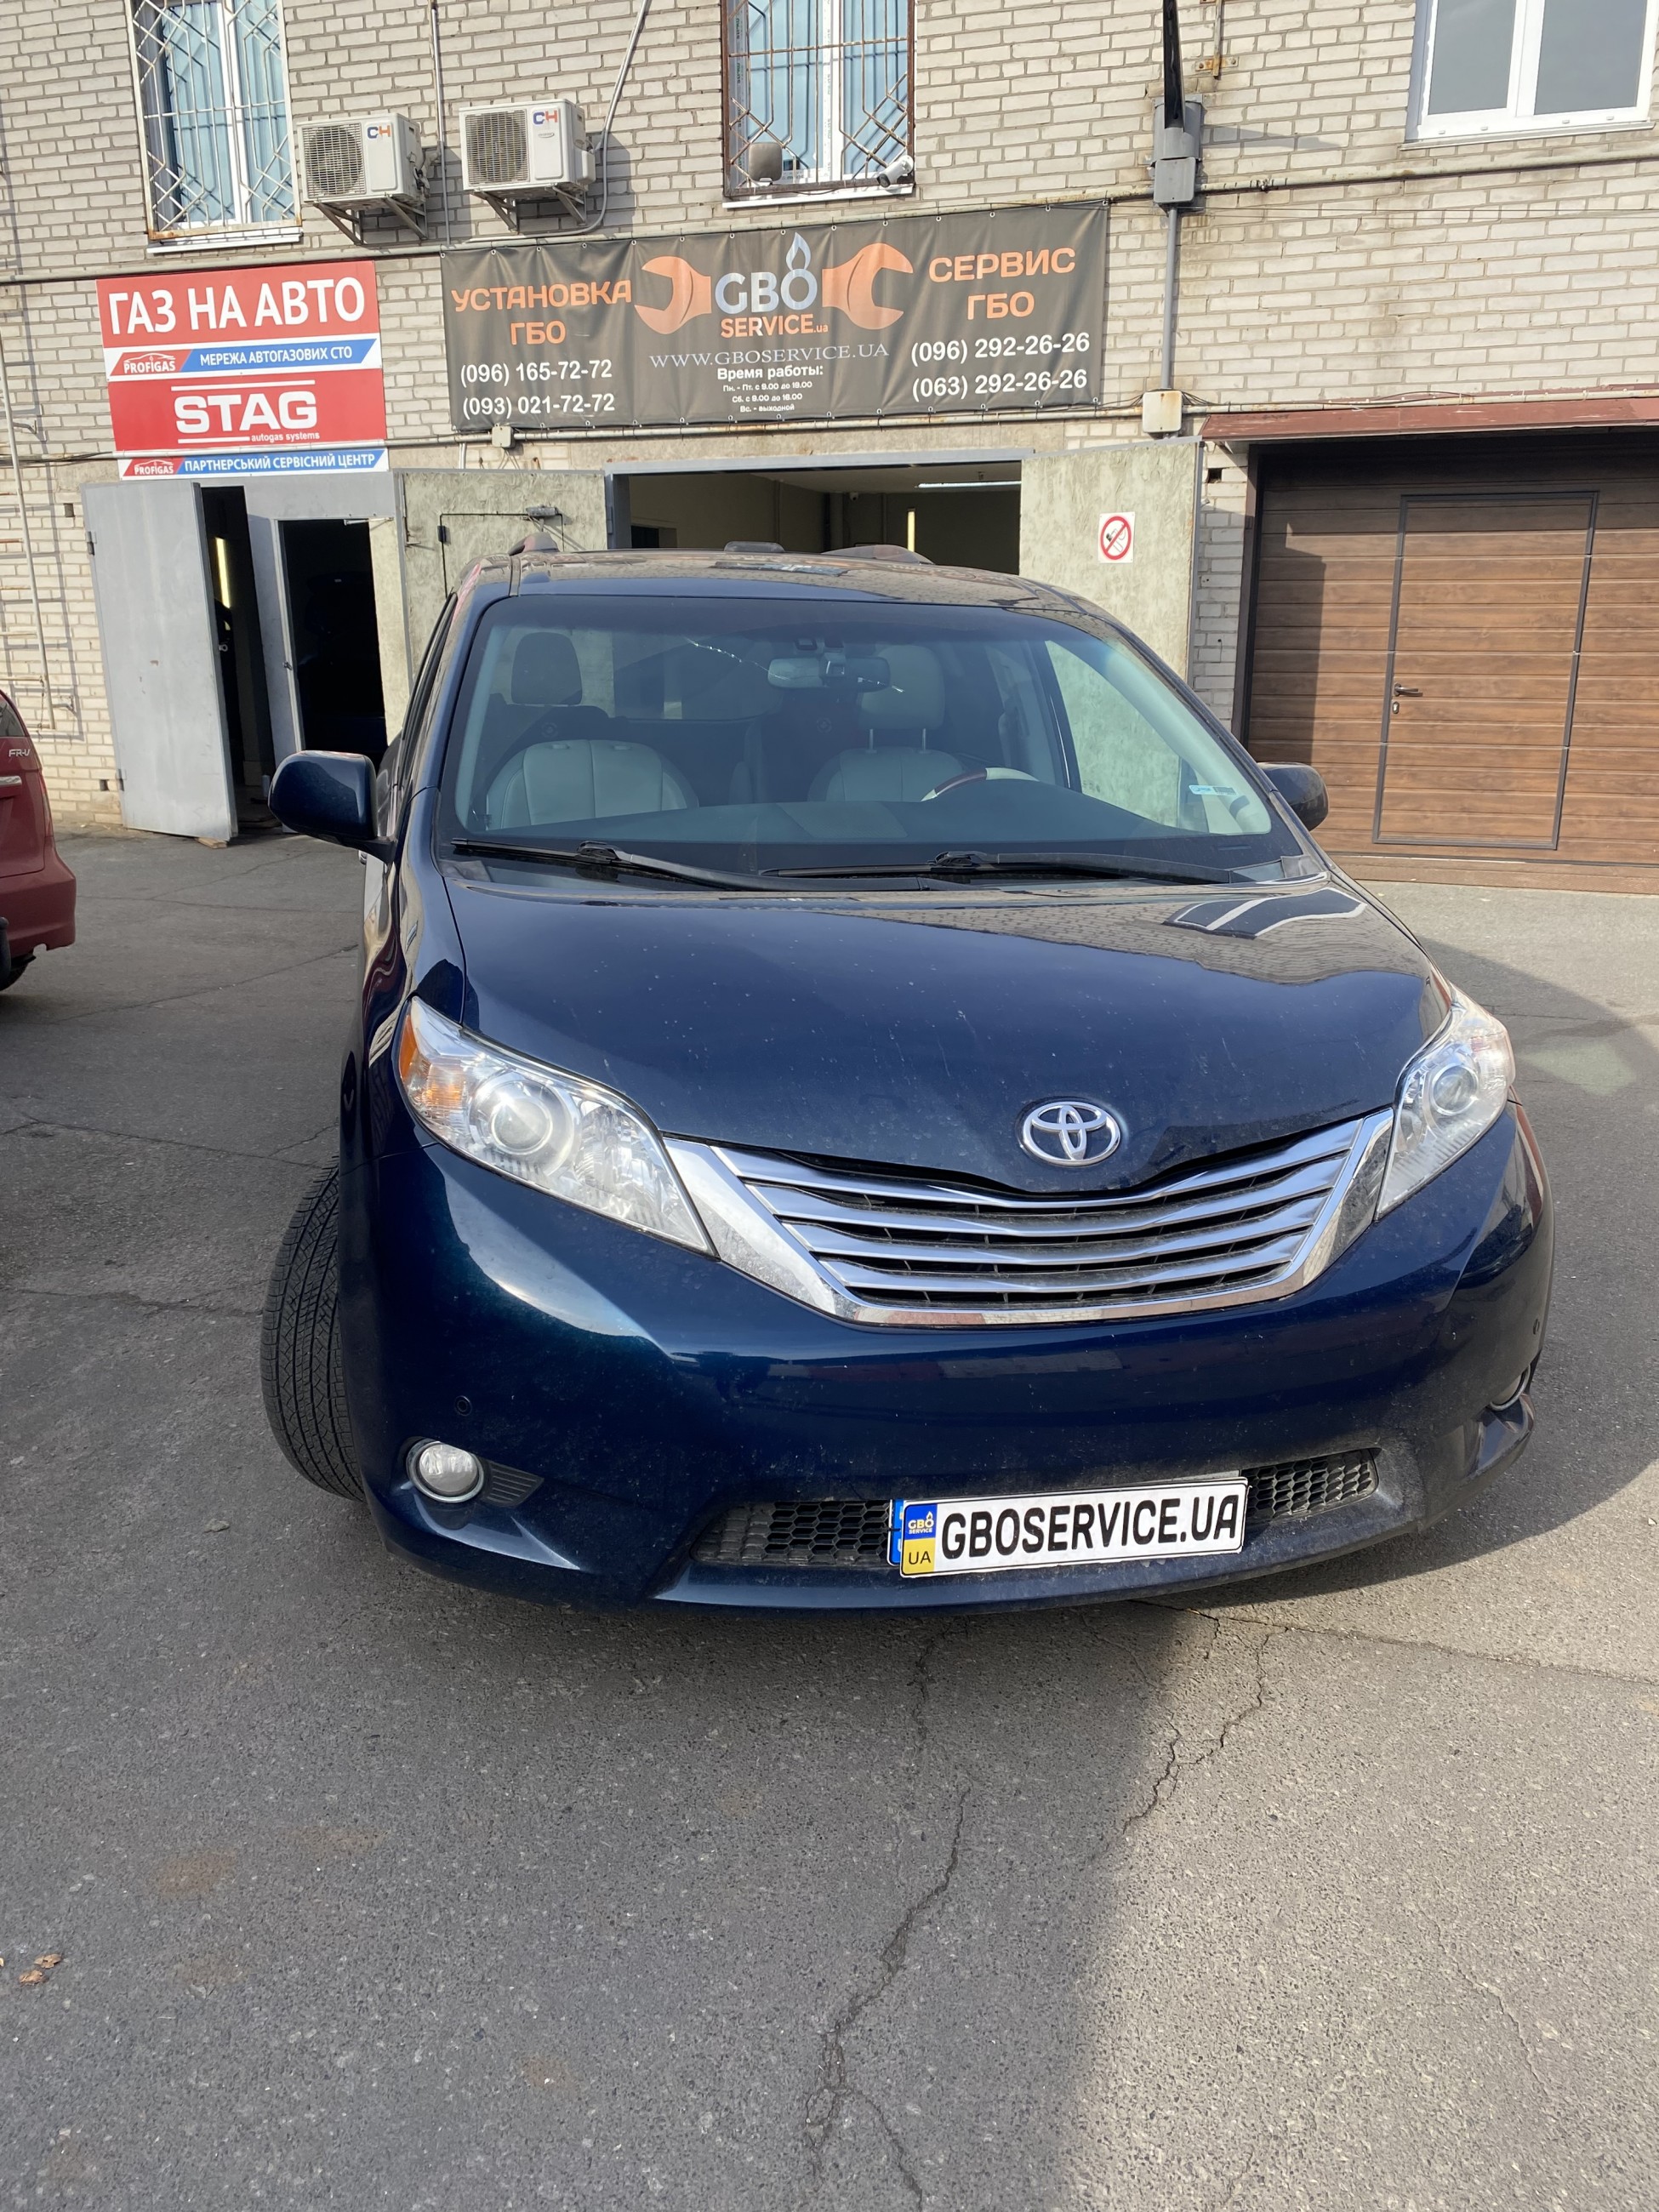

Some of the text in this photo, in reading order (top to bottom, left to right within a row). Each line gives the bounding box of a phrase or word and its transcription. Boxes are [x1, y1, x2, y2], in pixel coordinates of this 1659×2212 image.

[928, 247, 1076, 283] СЕРВИС
[451, 279, 631, 312] УСТАНОВКА
[715, 268, 818, 315] GBO
[108, 276, 366, 335] ГАЗ НА АВТО
[966, 291, 1035, 321] ГБО
[510, 320, 567, 345] ГБО
[200, 345, 353, 367] МЕРЕЖА АВТОГАЗОВИХ СТО
[649, 342, 890, 368] WWW.GBOSERVICE.UA
[910, 332, 1091, 367] (096) 292-26-26
[123, 360, 176, 374] PROFIGAS
[460, 359, 613, 388] (096) 165-72-72
[717, 365, 824, 382] Время работы:
[912, 368, 1088, 402] (063) 292-26-26
[174, 391, 317, 434] STAG
[463, 392, 615, 420] (093) 021-72-72
[758, 403, 795, 413] выходной
[251, 430, 320, 443] autogas systems
[134, 464, 174, 476] PROFIGAS
[185, 452, 376, 472] ПАРТНЕРСЬКИЙ СЕРВІСНИЙ ЦЕНТР
[908, 1519, 934, 1530] GBO
[941, 1494, 1240, 1560] GBOSERVICE.UA
[909, 1551, 932, 1565] UA
